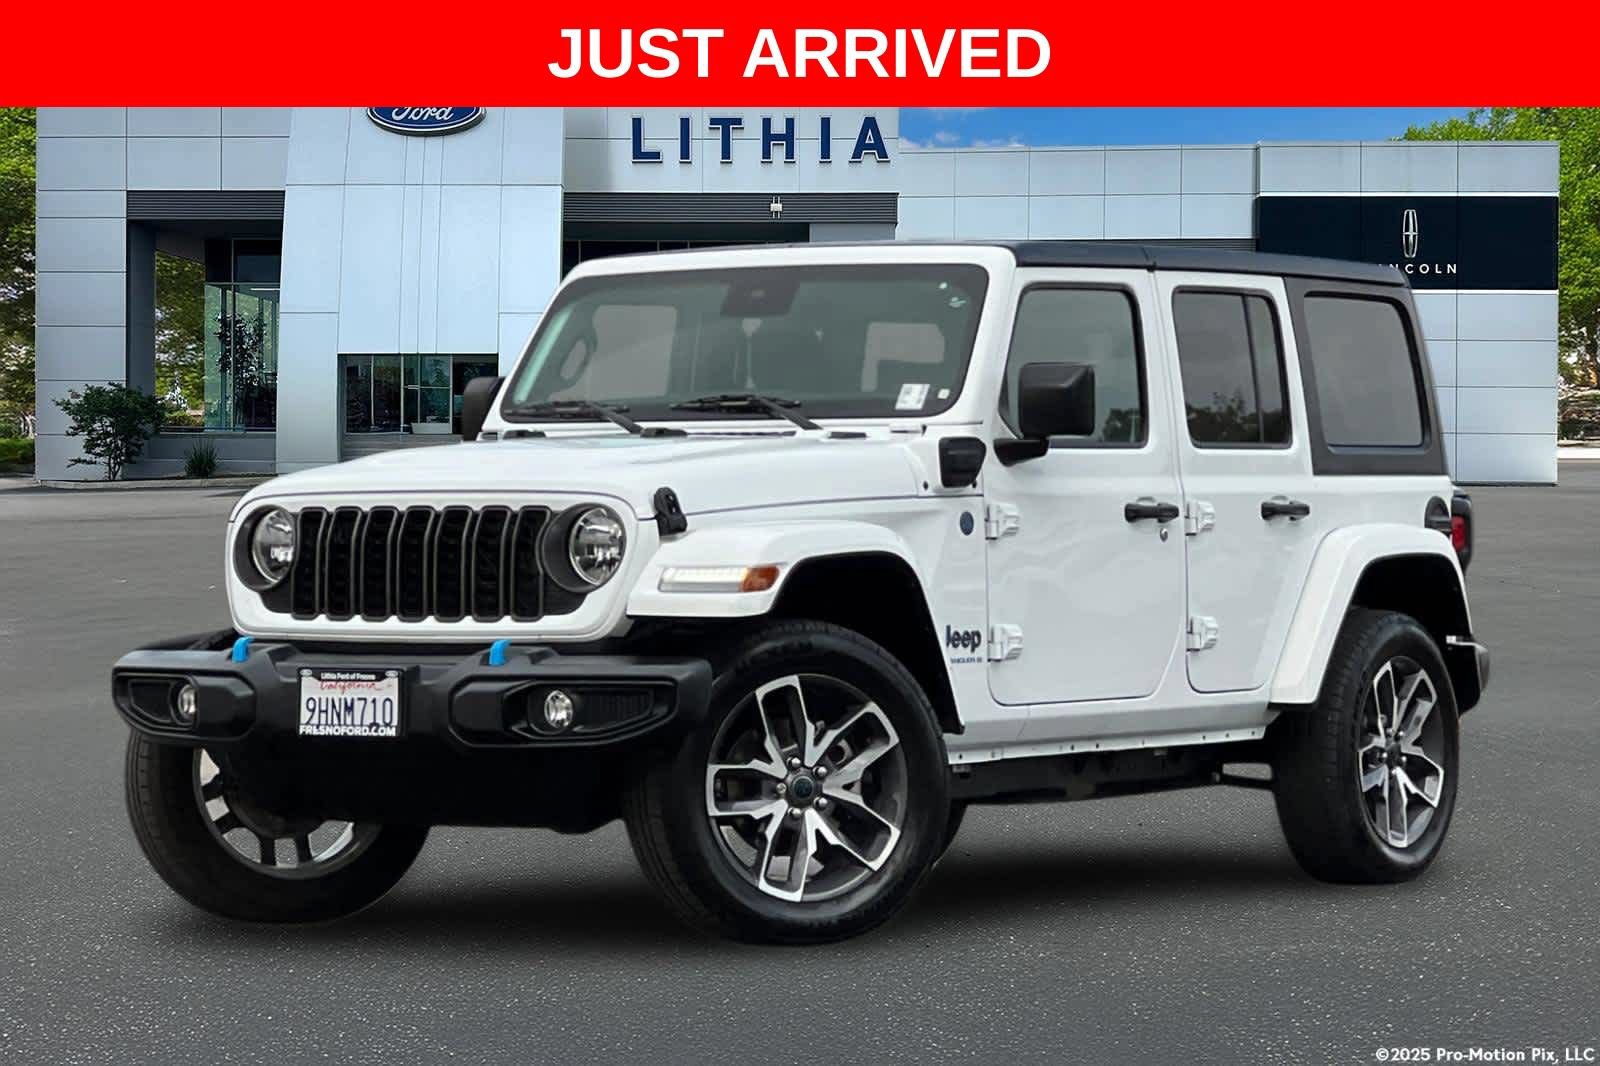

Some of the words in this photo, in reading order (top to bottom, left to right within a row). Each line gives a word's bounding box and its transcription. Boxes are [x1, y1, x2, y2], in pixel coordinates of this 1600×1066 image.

[631, 116, 890, 163] LITHIA
[1378, 263, 1457, 275] NCOLN
[306, 696, 393, 726] 9HNM710
